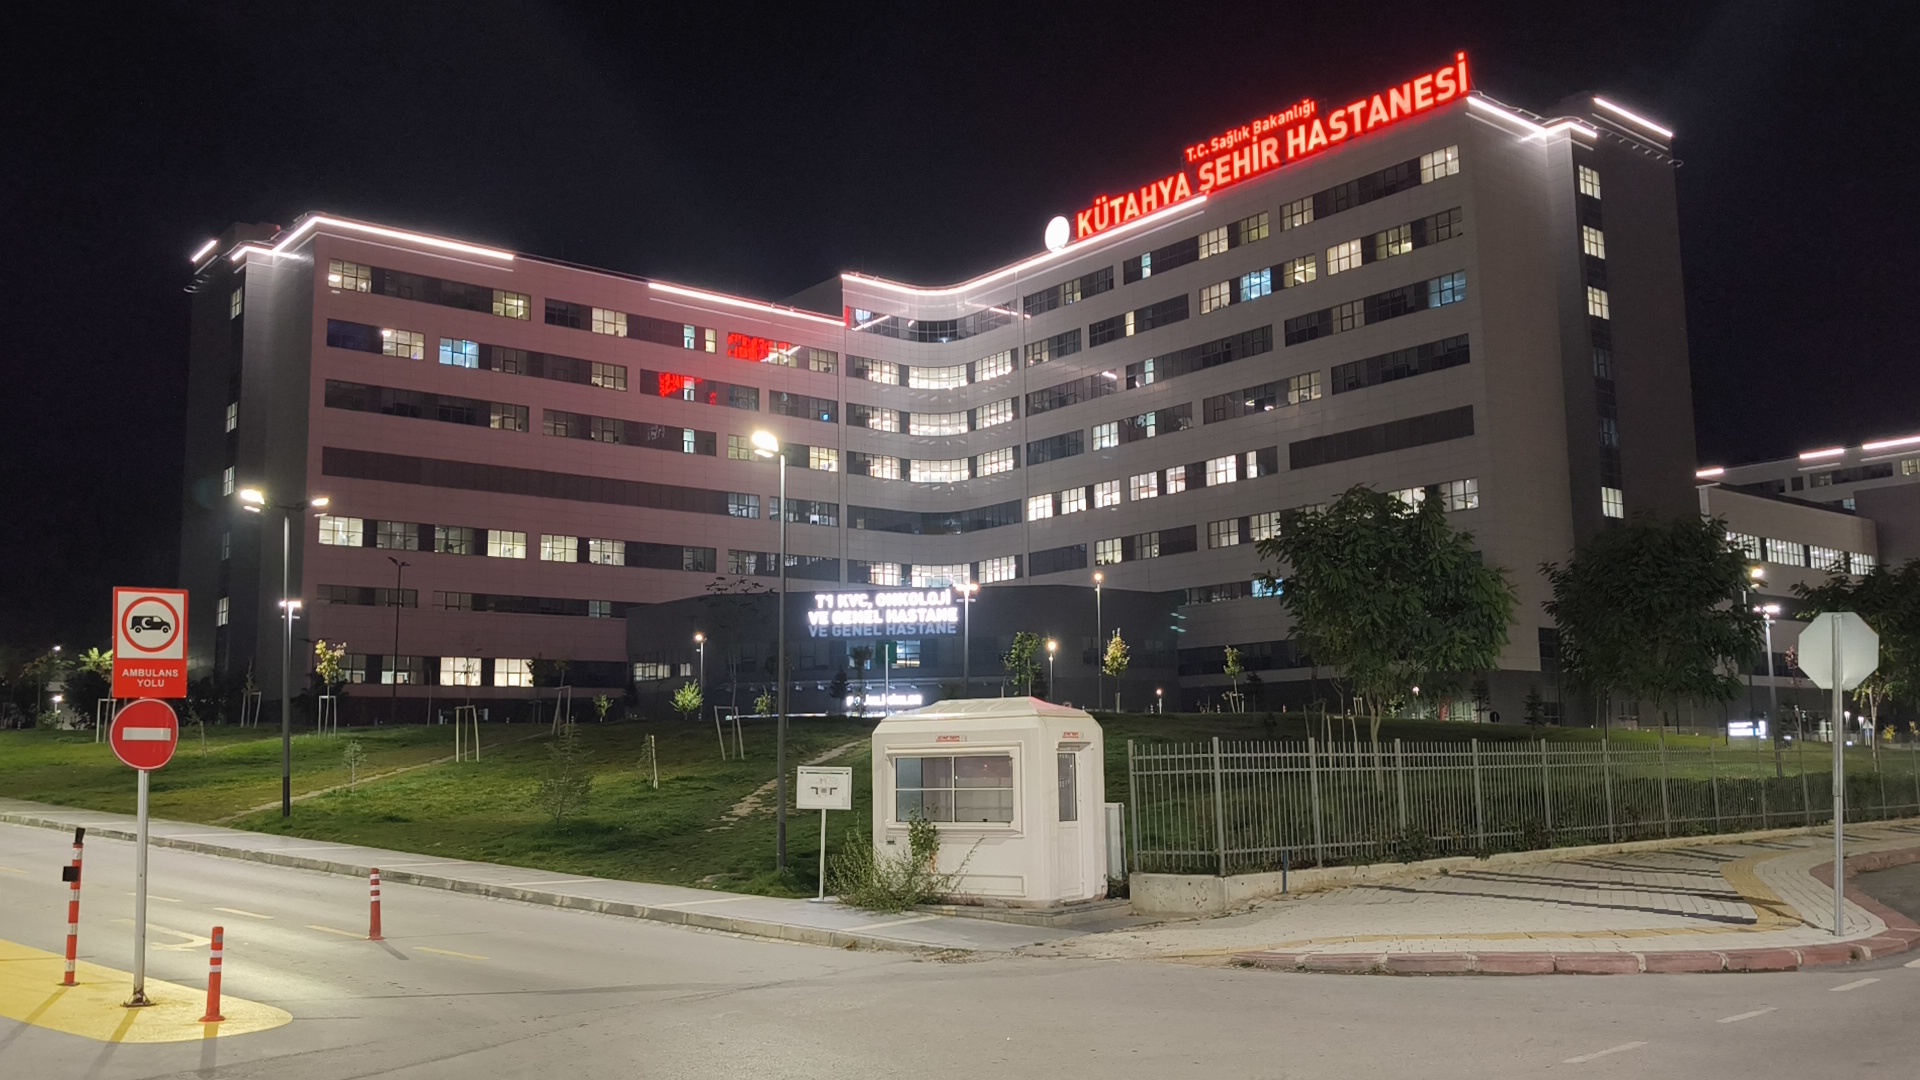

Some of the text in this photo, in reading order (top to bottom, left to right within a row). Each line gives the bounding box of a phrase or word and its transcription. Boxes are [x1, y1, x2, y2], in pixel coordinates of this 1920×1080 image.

[1186, 98, 1316, 162] T.C. Sağlık Bakanlığı
[1077, 52, 1469, 238] KÜTAHYA ŞEHİR HASTANESİ
[875, 588, 951, 607] ONKOLOJİ
[808, 607, 958, 625] VE GENEL HASTANE
[808, 622, 957, 637] VE GENEL HASTANE
[122, 668, 179, 678] AMBULANS
[137, 679, 165, 688] YOLU
